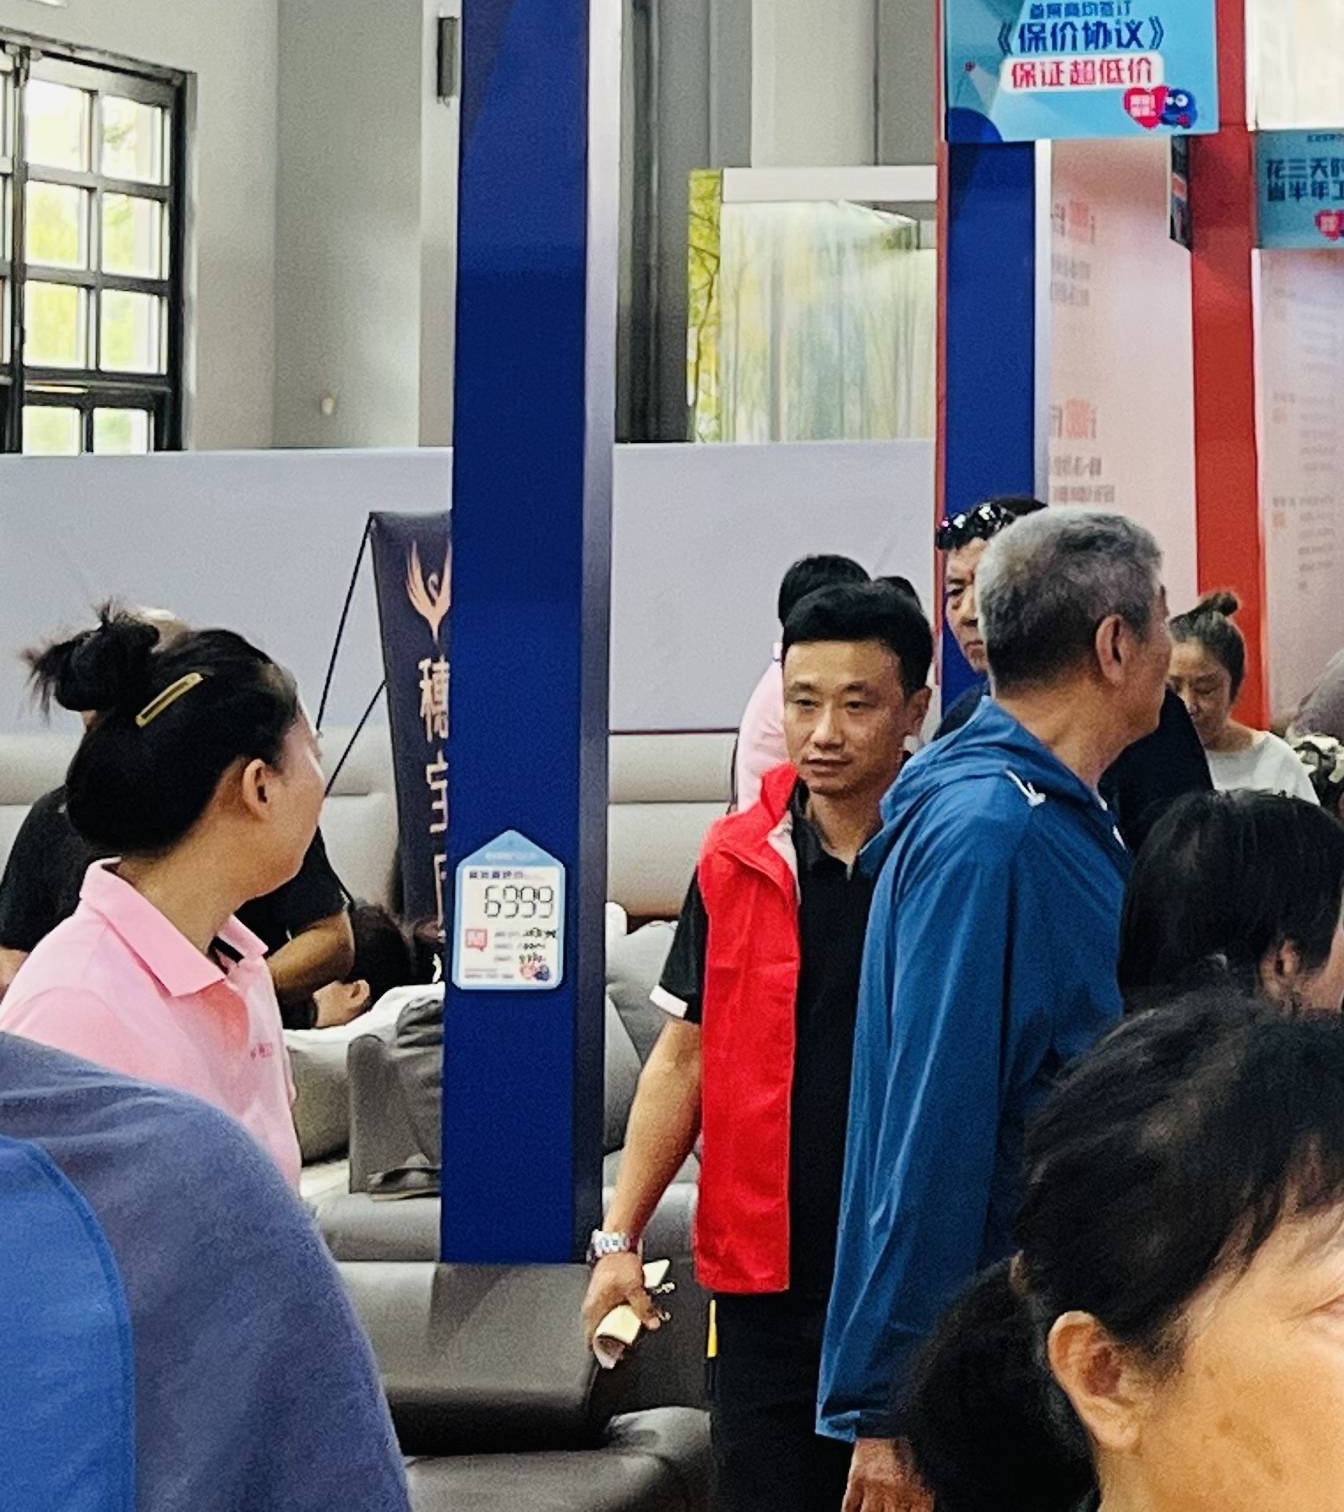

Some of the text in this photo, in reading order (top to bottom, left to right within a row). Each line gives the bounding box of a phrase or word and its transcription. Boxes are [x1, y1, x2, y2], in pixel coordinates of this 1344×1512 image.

[997, 16, 1164, 56] 《保价协议》
[1011, 57, 1152, 88] 保证超低价
